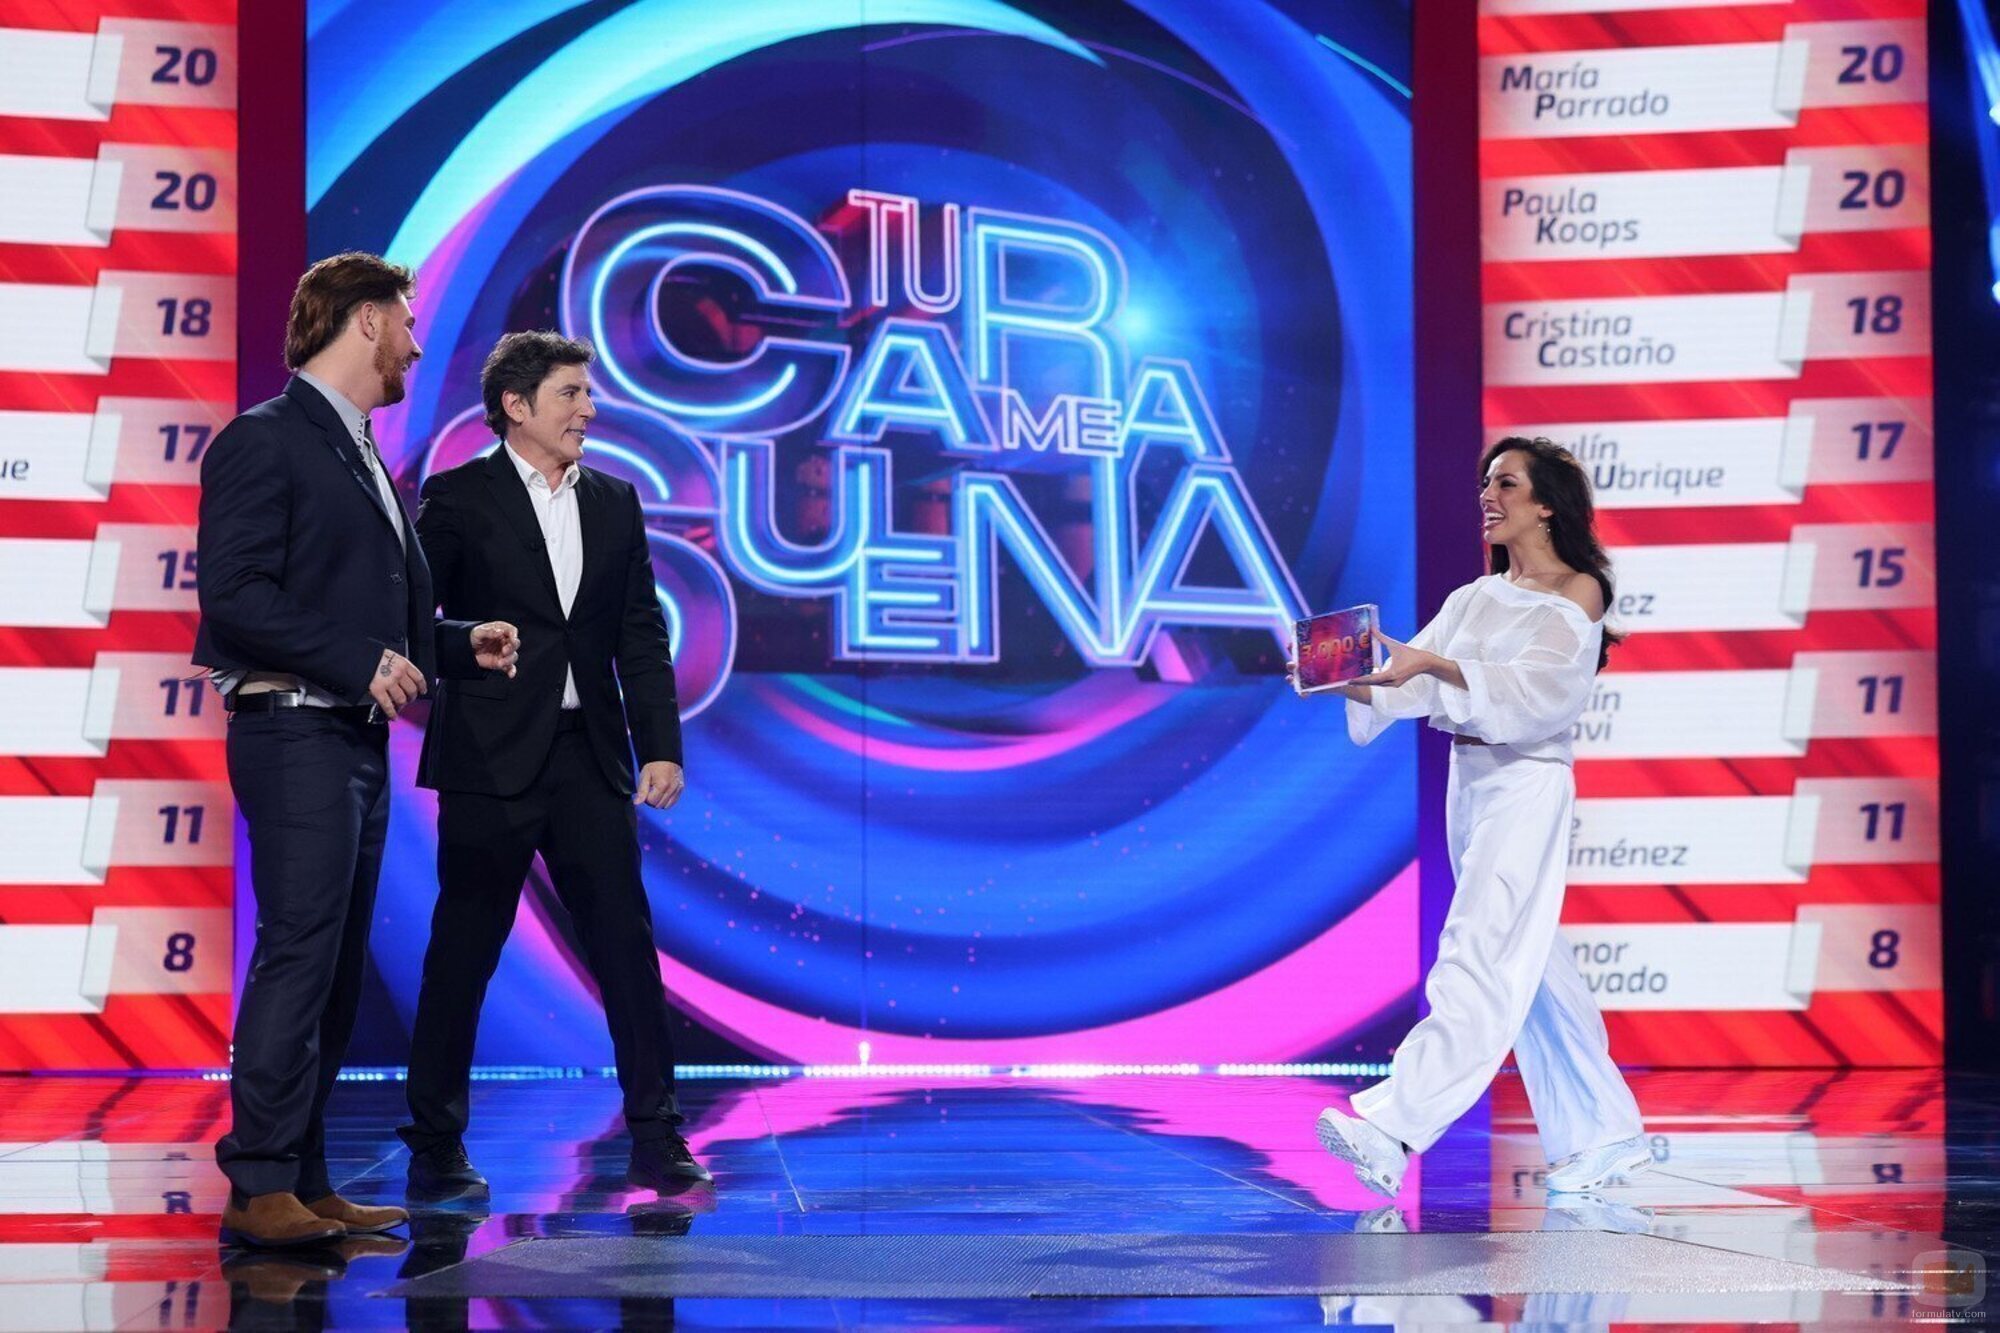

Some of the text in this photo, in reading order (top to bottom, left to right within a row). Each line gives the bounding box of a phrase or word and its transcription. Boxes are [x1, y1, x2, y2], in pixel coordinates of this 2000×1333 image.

[151, 46, 217, 86] 20
[1501, 62, 1599, 91] María
[1837, 44, 1904, 84] 20
[1535, 88, 1669, 119] Parrado
[150, 172, 217, 211] 20
[1503, 188, 1597, 216] Paula
[1839, 170, 1906, 210] 20
[848, 189, 961, 314] TU
[1536, 217, 1639, 248] Koops
[157, 298, 211, 337] 18
[561, 184, 1232, 464] CARA
[1504, 310, 1631, 340] Cristina
[1847, 296, 1903, 335] 18
[1538, 337, 1675, 368] Castaño
[159, 424, 211, 462] 17
[1001, 389, 1124, 459] ME
[1851, 422, 1906, 460] 17
[1593, 462, 1725, 496] Ubrique
[157, 551, 198, 589] 15
[1853, 549, 1906, 587] 15
[159, 679, 204, 716] 11
[1857, 676, 1904, 713] 11
[158, 806, 204, 843] 11
[1859, 803, 1906, 841] 11
[1567, 837, 1689, 867] iménez
[163, 933, 195, 972] 8
[1868, 930, 1899, 969] 8
